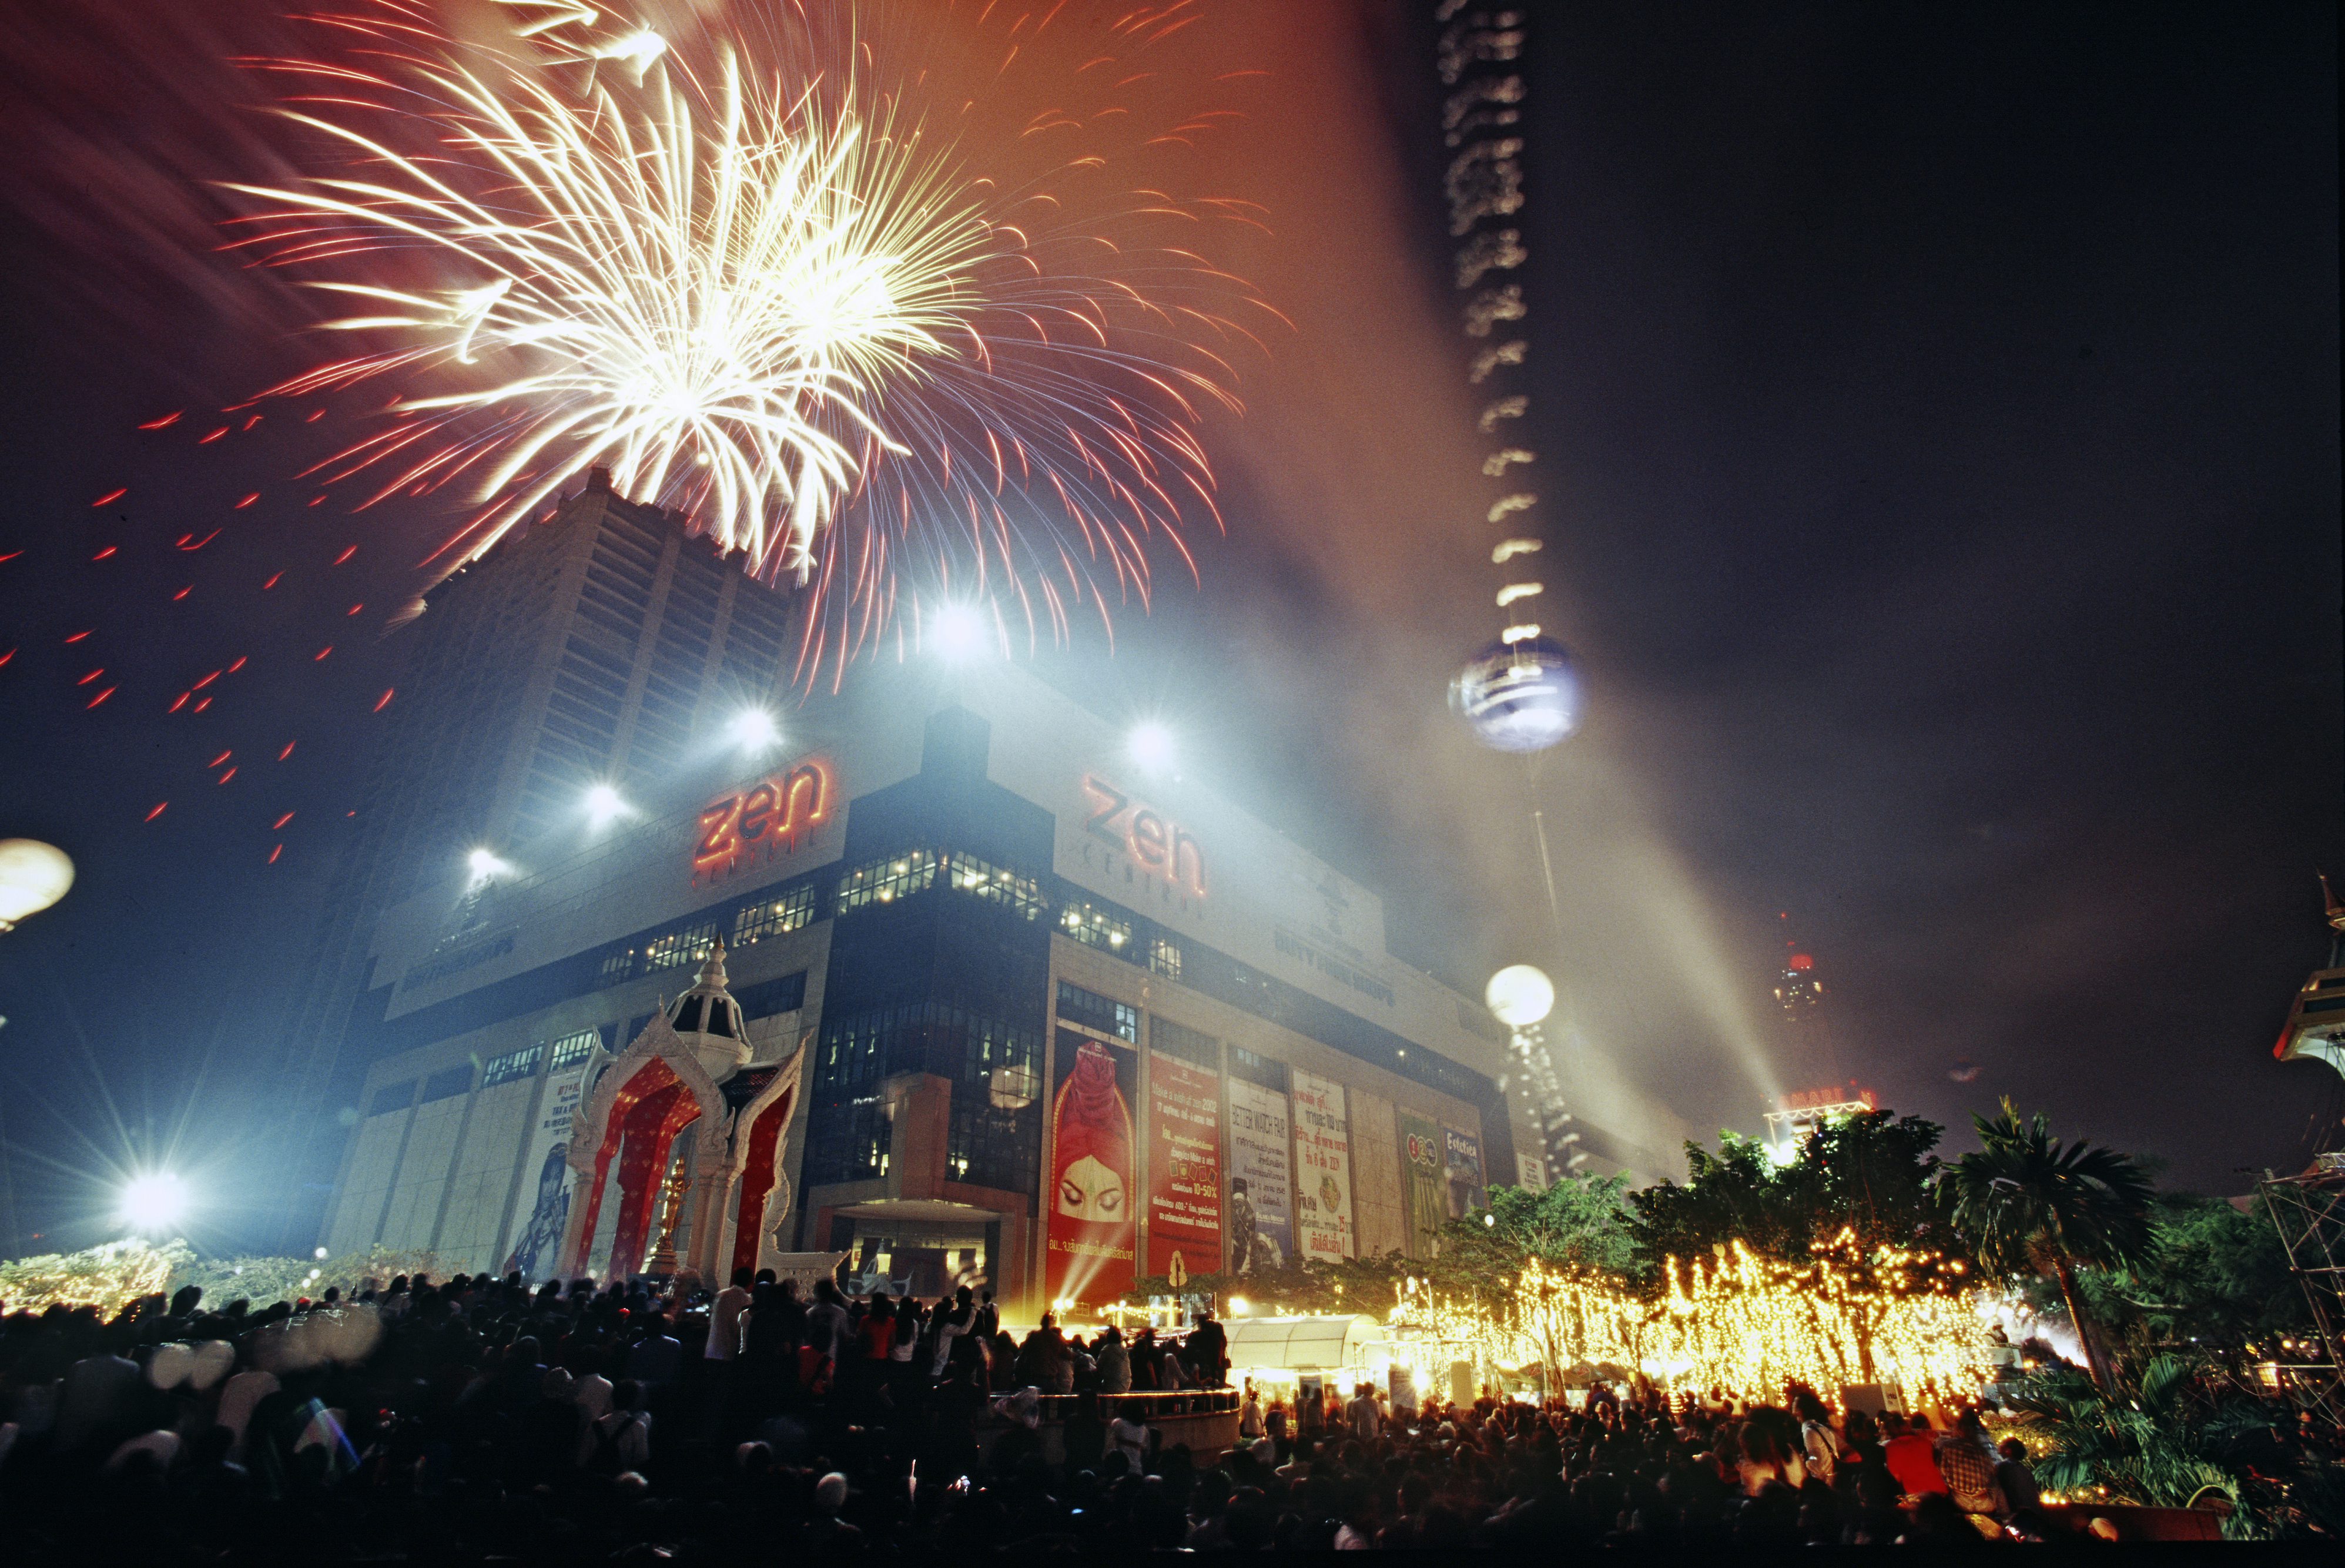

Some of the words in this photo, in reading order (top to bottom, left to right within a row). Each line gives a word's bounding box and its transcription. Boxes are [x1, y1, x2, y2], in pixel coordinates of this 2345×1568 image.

[694, 762, 826, 863] zen
[1083, 775, 1207, 895] zen
[1202, 1098, 1217, 1113] 2002
[1232, 1104, 1252, 1130] BETTER
[1253, 1110, 1273, 1135] WATCH
[1273, 1115, 1285, 1139] FAIR
[1194, 1182, 1218, 1198] 10-50%
